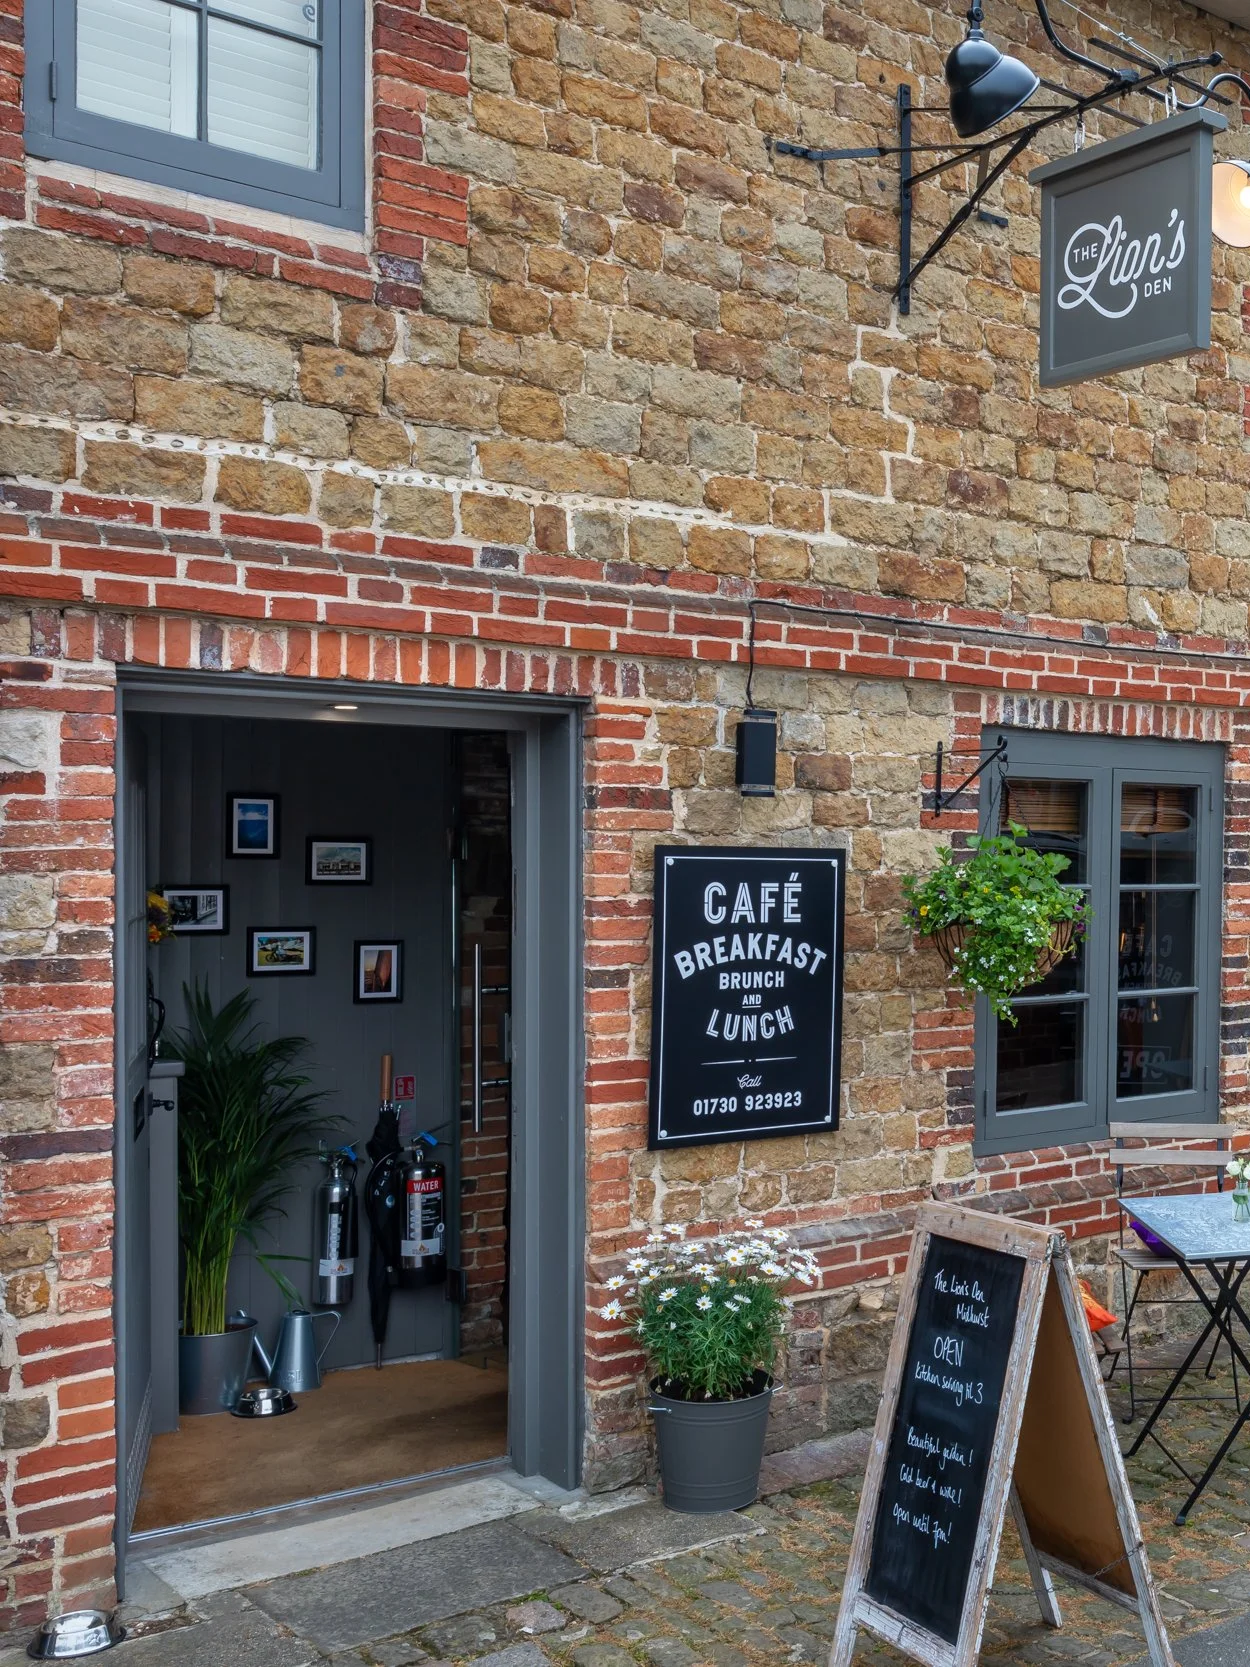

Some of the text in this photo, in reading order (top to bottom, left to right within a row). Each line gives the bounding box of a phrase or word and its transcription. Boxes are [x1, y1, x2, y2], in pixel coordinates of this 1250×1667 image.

[1058, 208, 1186, 319] Lion's
[1073, 243, 1098, 264] THE
[1144, 276, 1172, 298] DEN
[704, 872, 802, 925] CAFÉ
[674, 933, 827, 980] BREAKFAST
[719, 971, 785, 990] BRUNCH
[742, 994, 762, 1006] AND
[706, 1005, 795, 1042] LUNCH
[737, 1074, 762, 1089] Call
[693, 1091, 802, 1116] 01730 923923
[413, 1180, 439, 1192] WATER
[934, 1268, 985, 1303] The Lion's Den
[956, 1302, 990, 1328] Midhurst
[933, 1335, 964, 1367] OPEN
[974, 1382, 984, 1405] 3
[900, 1463, 914, 1483] Cold
[915, 1468, 931, 1489] beer
[912, 1513, 930, 1534] until
